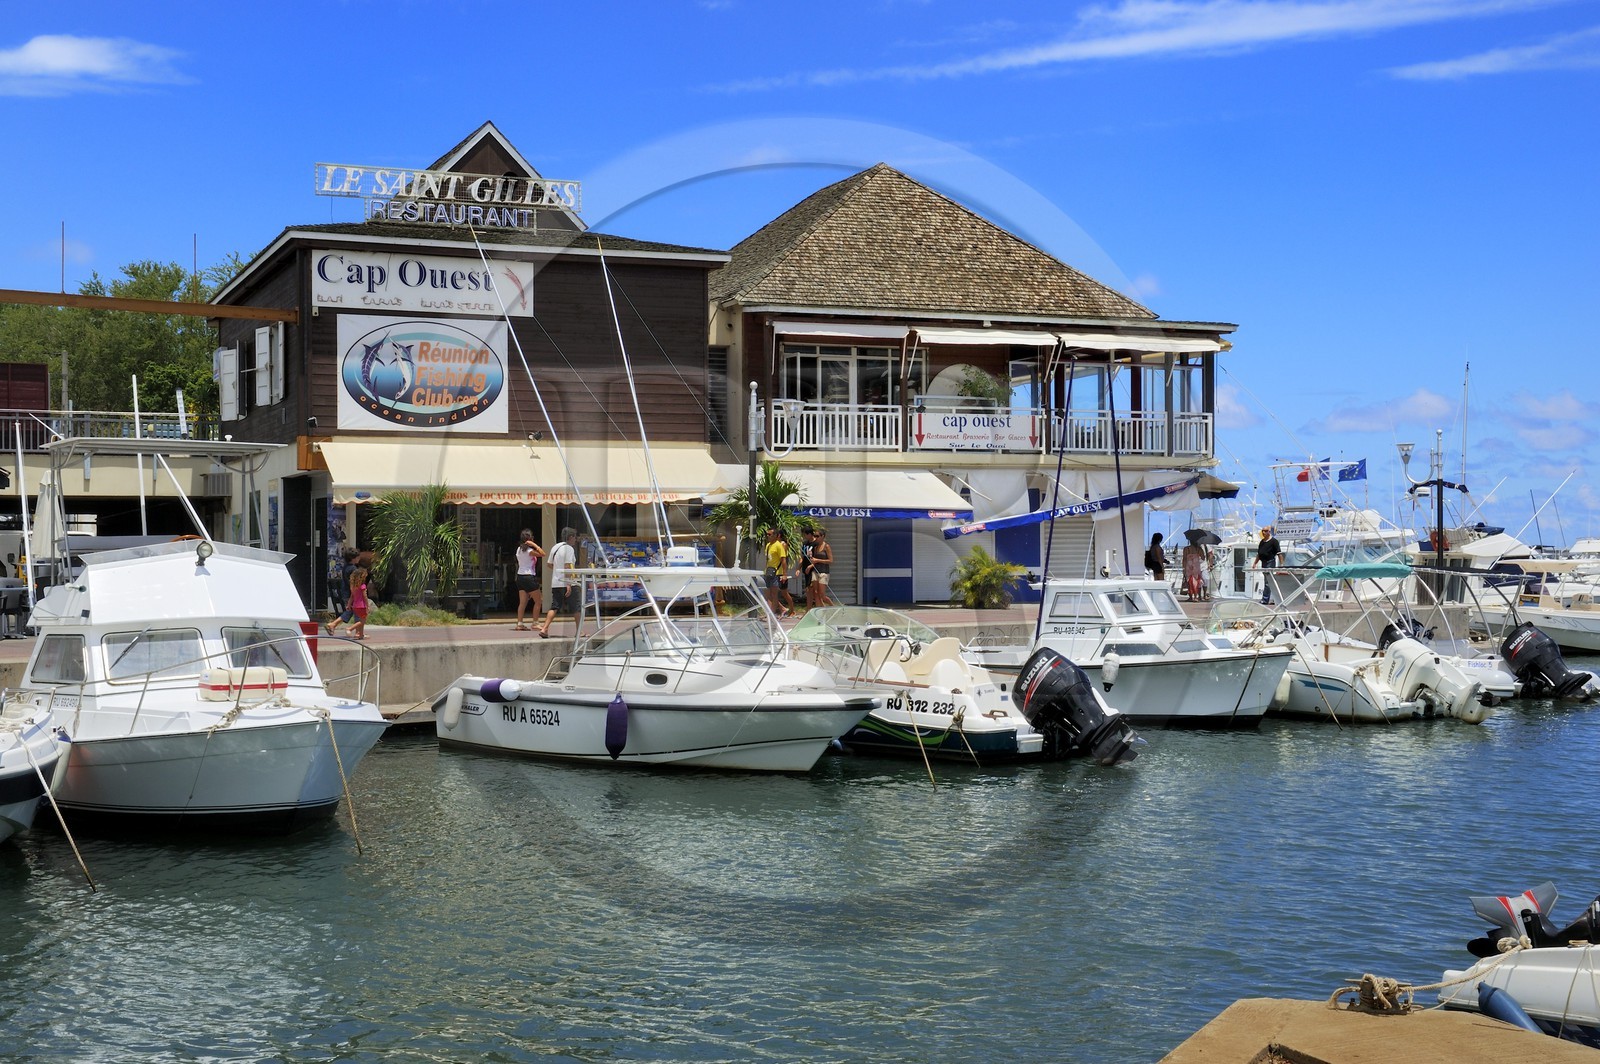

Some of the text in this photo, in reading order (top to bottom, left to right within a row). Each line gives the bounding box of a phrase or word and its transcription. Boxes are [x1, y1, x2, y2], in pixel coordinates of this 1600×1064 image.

[320, 165, 580, 208] LE SAINT GILLES
[370, 200, 533, 228] RESTAURANT
[317, 254, 494, 292] Cap Ouest
[417, 341, 490, 365] Réunion
[414, 366, 488, 393] Fishing
[359, 395, 416, 423] ocean
[411, 388, 479, 409] Club.com
[942, 415, 1011, 432] cap ouest
[926, 432, 959, 440] Restaurant
[962, 432, 990, 441] Brasserie
[994, 433, 1005, 441] Bar
[479, 492, 522, 500] LOCATION
[526, 492, 539, 500] DE
[593, 493, 634, 501] ARTICLES
[637, 493, 649, 501] DE
[809, 507, 873, 518] CAP OUEST
[1072, 501, 1103, 514] OUEST
[1509, 630, 1532, 650] SUZUKI
[1019, 656, 1049, 692] SUZUKI
[502, 705, 561, 727] RU A 65524
[886, 698, 903, 711] RU
[932, 702, 955, 716] 232
